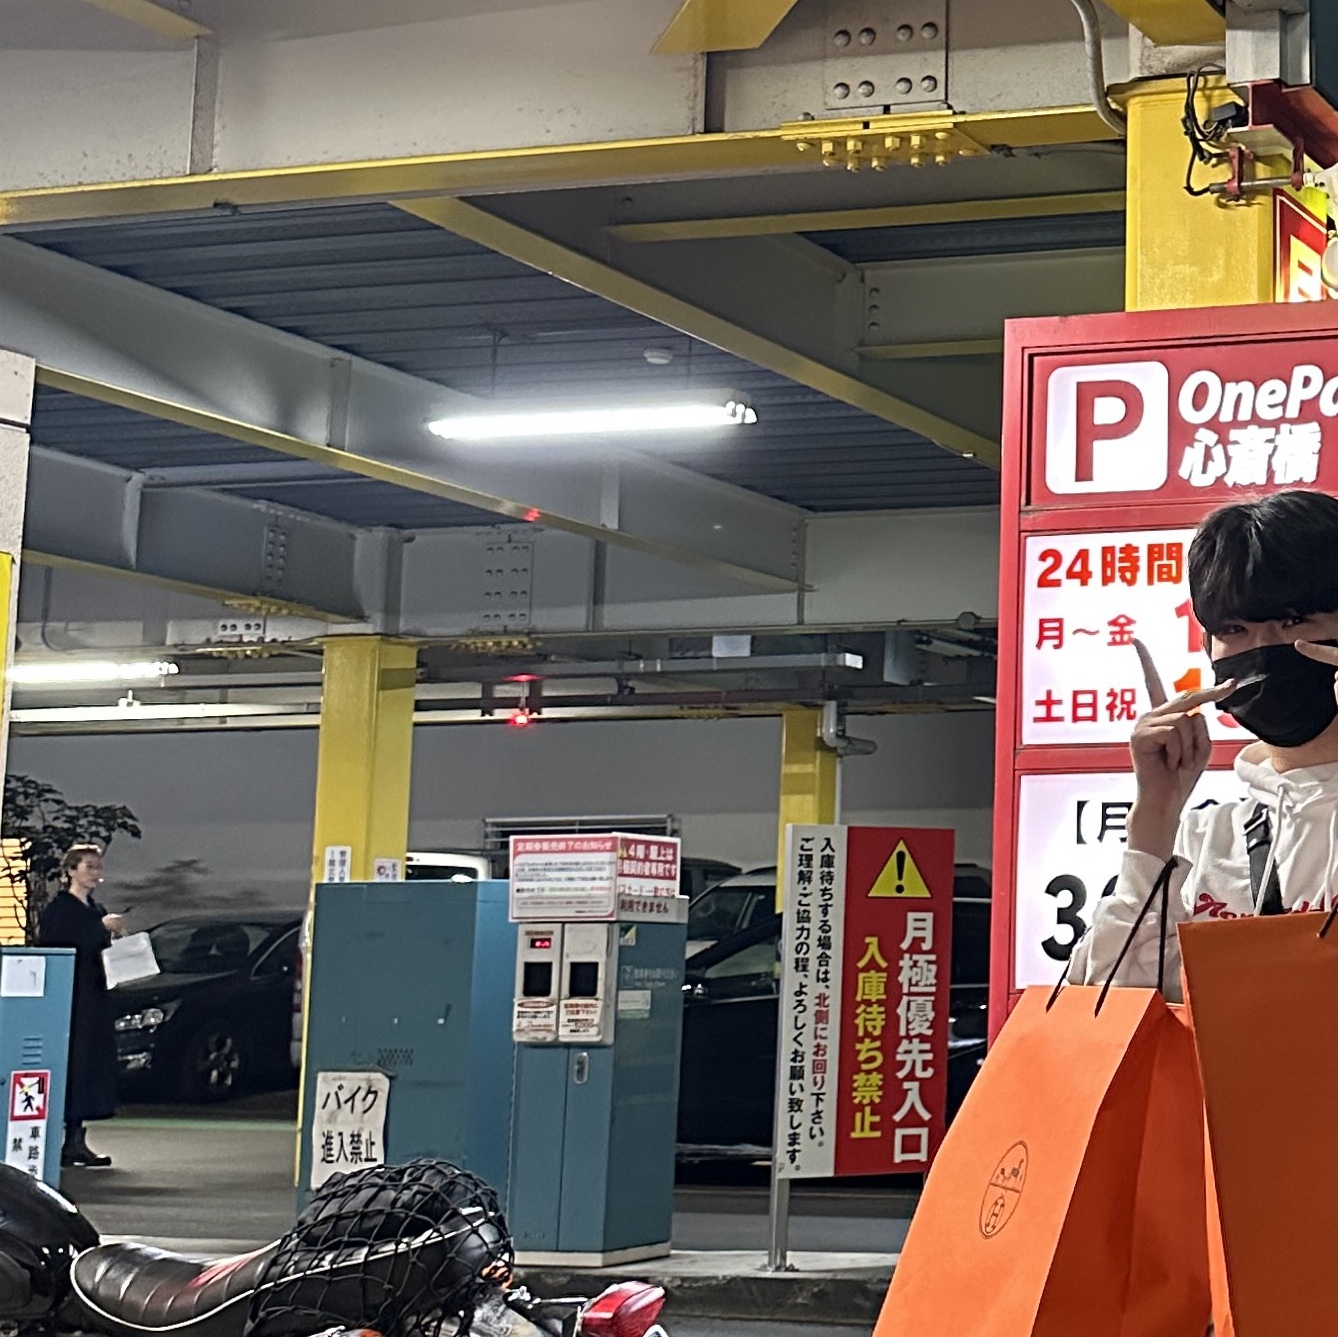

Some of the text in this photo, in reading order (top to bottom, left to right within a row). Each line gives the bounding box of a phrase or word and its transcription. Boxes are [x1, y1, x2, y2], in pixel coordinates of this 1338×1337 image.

[1074, 379, 1145, 483] P
[1033, 687, 1137, 724] 土日祝
[850, 936, 889, 1139] 入庫待ち禁止
[892, 911, 938, 1164] 月極優先入口
[321, 1085, 379, 1115] バイク
[320, 1130, 378, 1165] 進入禁止
